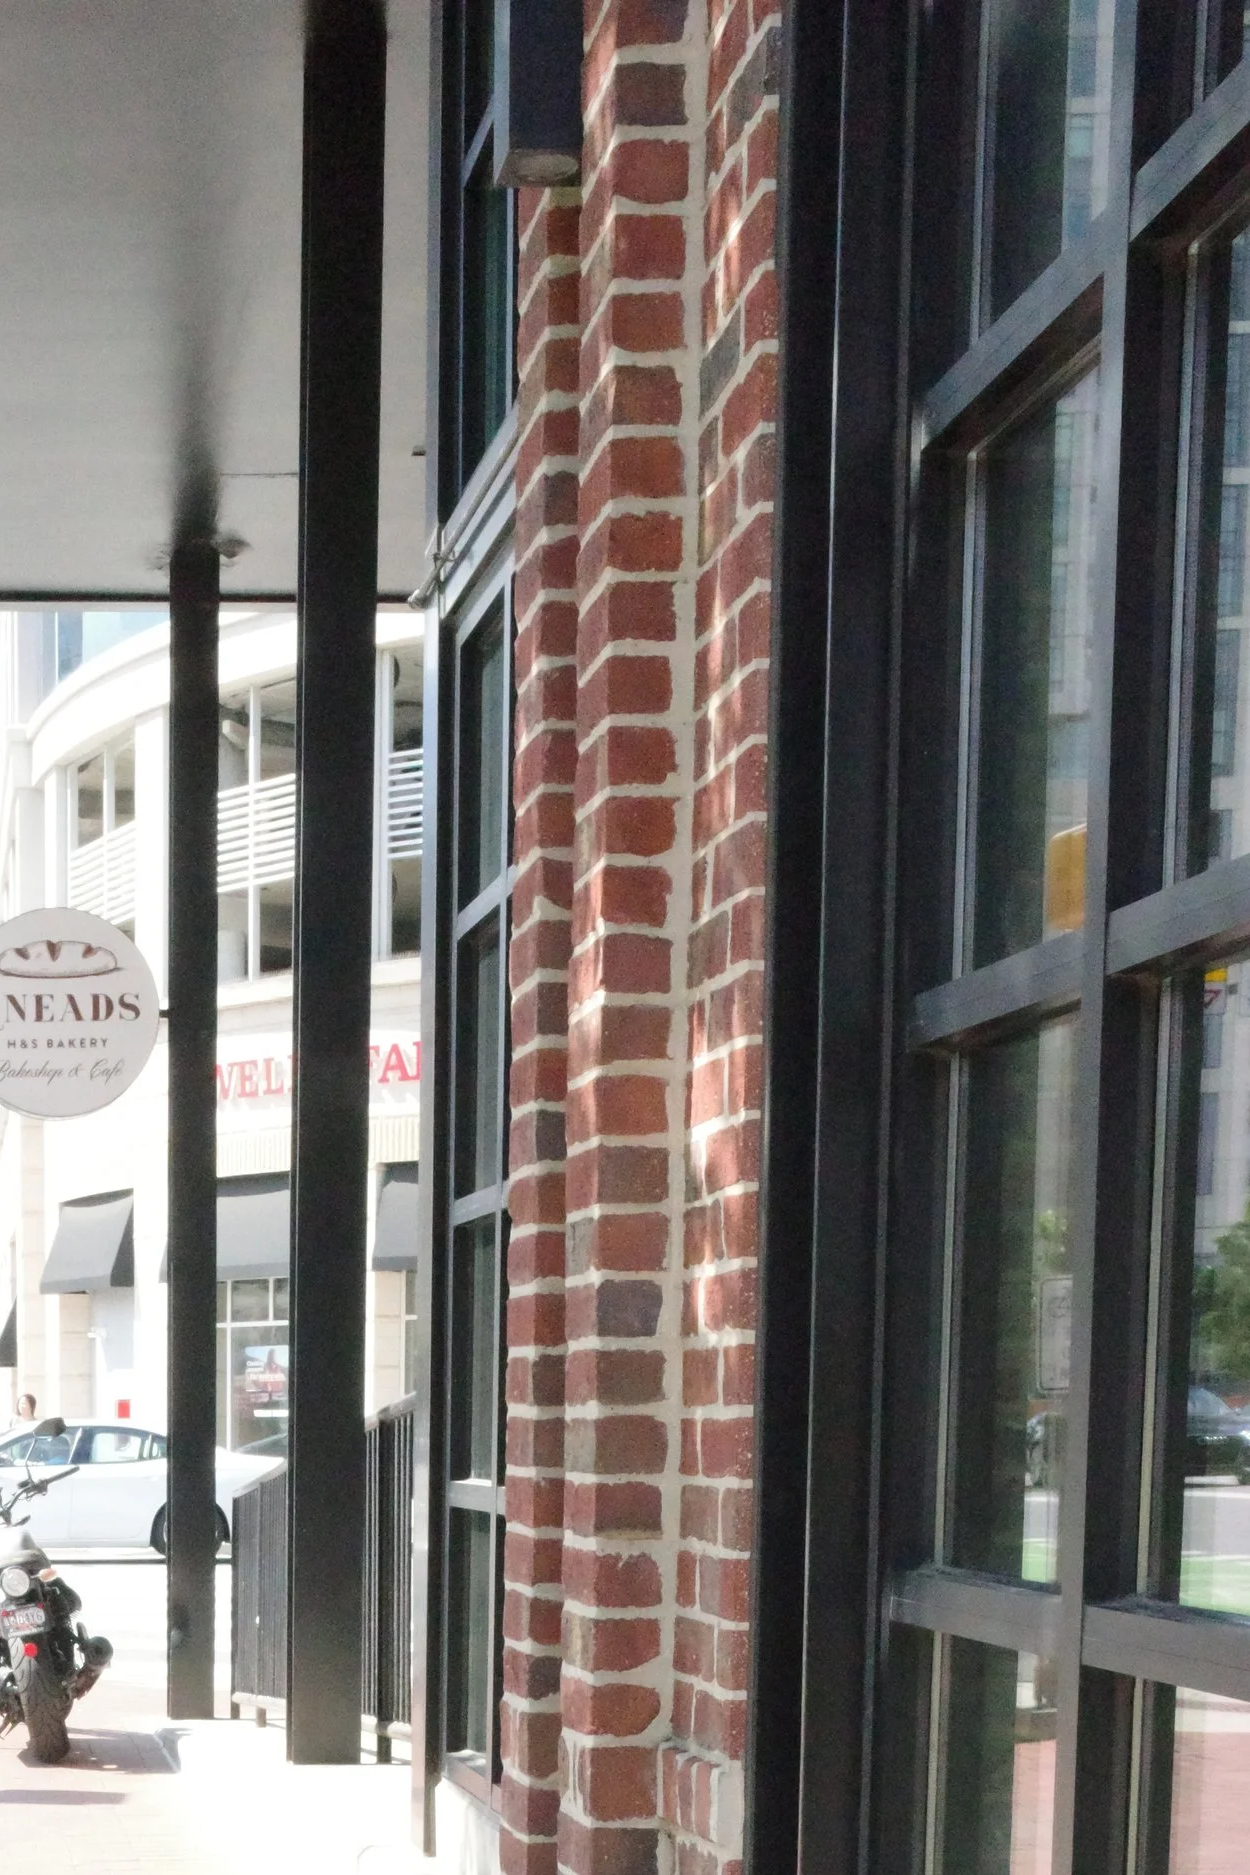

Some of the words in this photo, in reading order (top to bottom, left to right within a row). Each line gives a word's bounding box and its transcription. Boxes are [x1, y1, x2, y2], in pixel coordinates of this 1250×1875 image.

[7, 1038, 38, 1049] H&S
[47, 1038, 108, 1049] BAKERY
[68, 1063, 84, 1077] &
